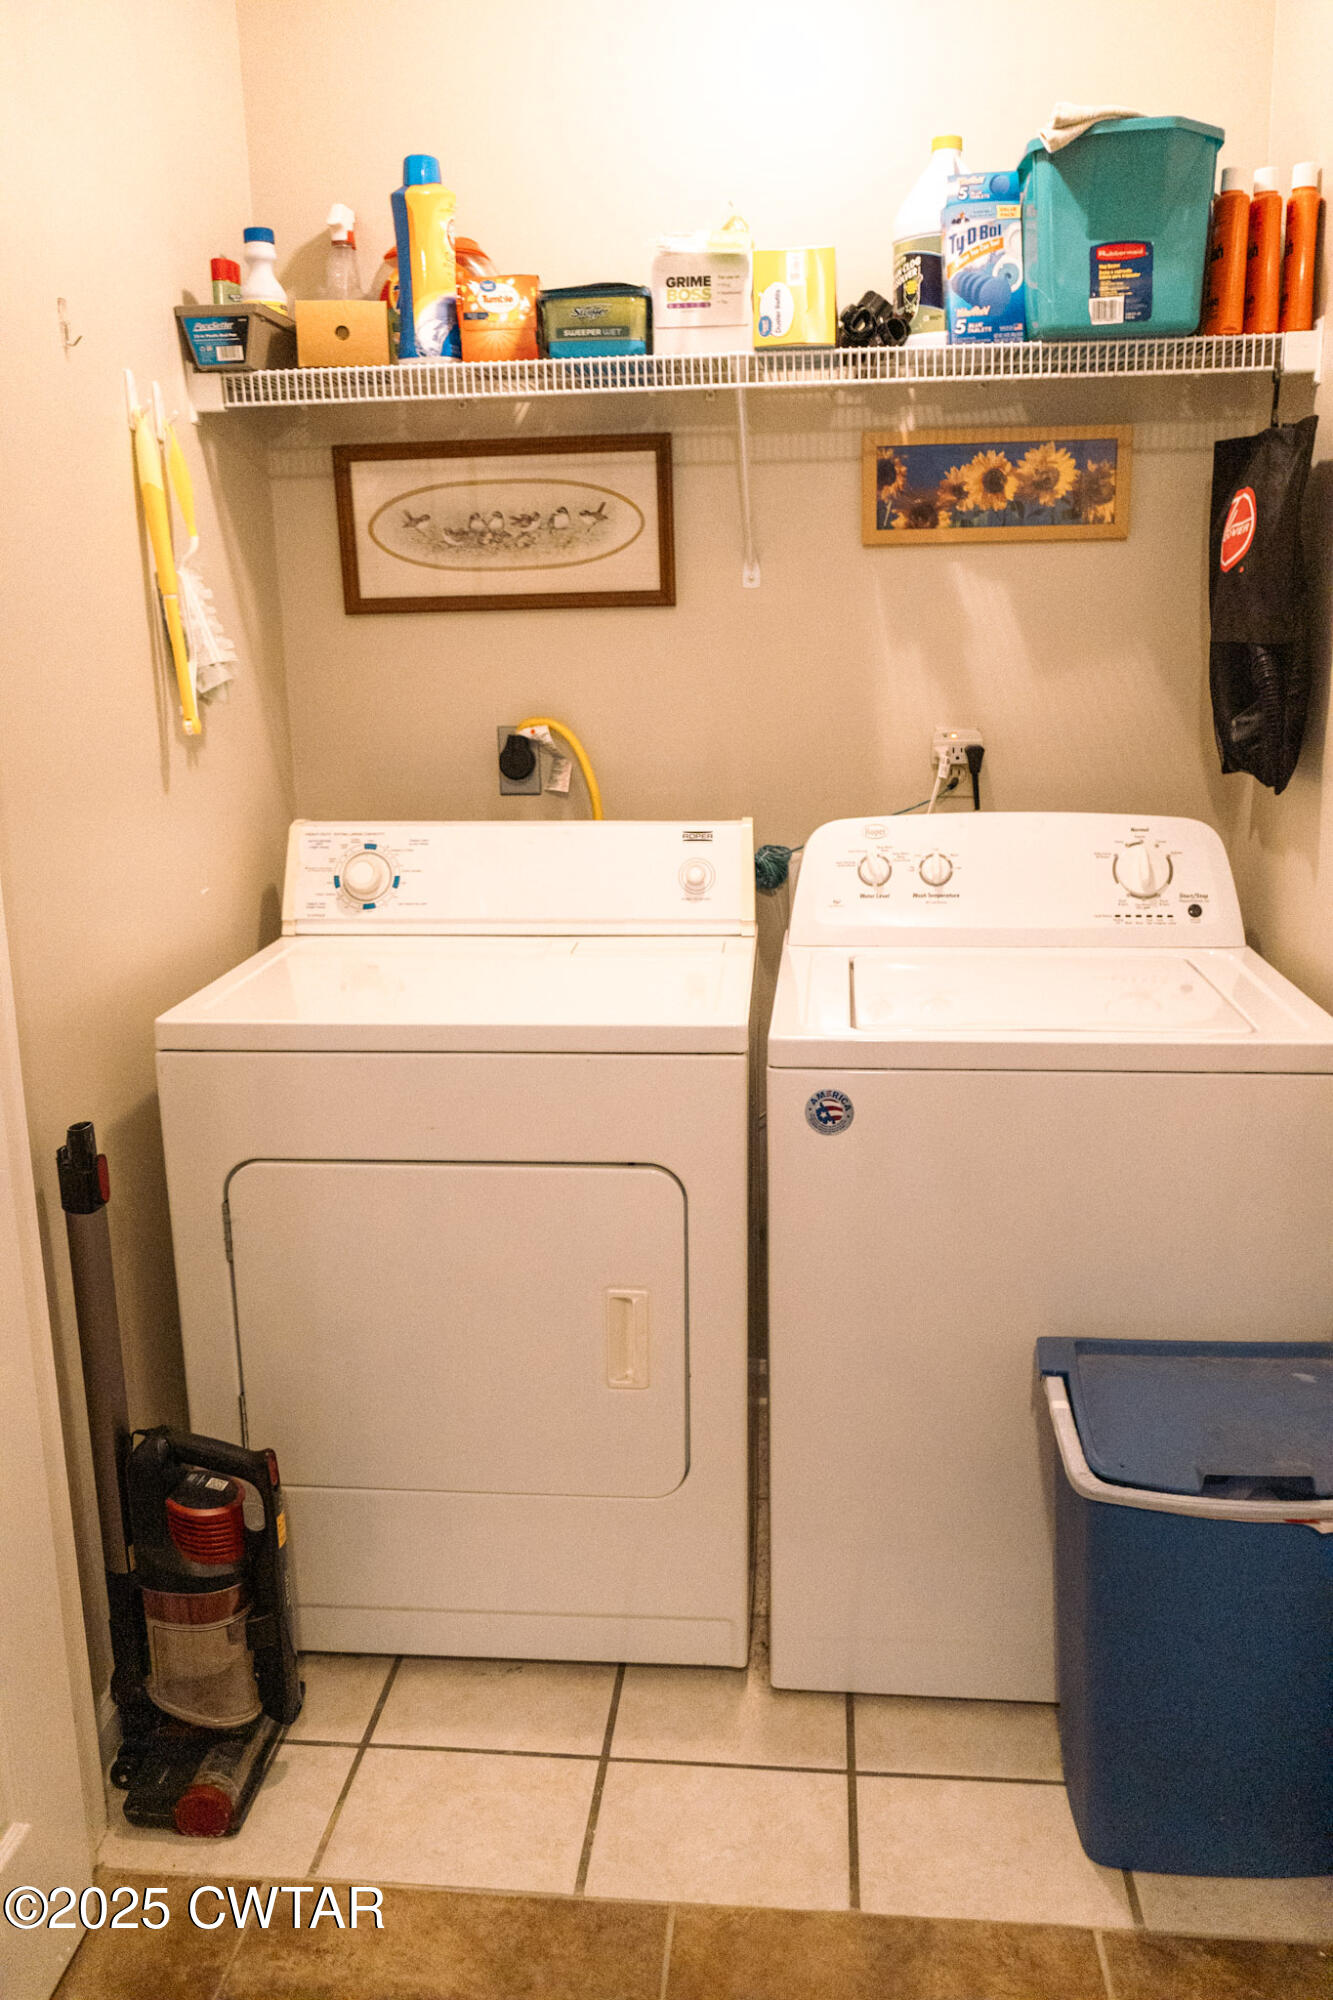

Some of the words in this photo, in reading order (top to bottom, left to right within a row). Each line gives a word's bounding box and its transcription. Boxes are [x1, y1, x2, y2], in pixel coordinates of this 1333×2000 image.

[957, 184, 969, 200] 5
[665, 275, 712, 288] GRIME
[666, 288, 712, 302] BOSS
[563, 328, 601, 337] SWEEPER
[602, 328, 622, 336] WET
[954, 318, 967, 334] 5
[810, 1090, 851, 1111] AMERICA
